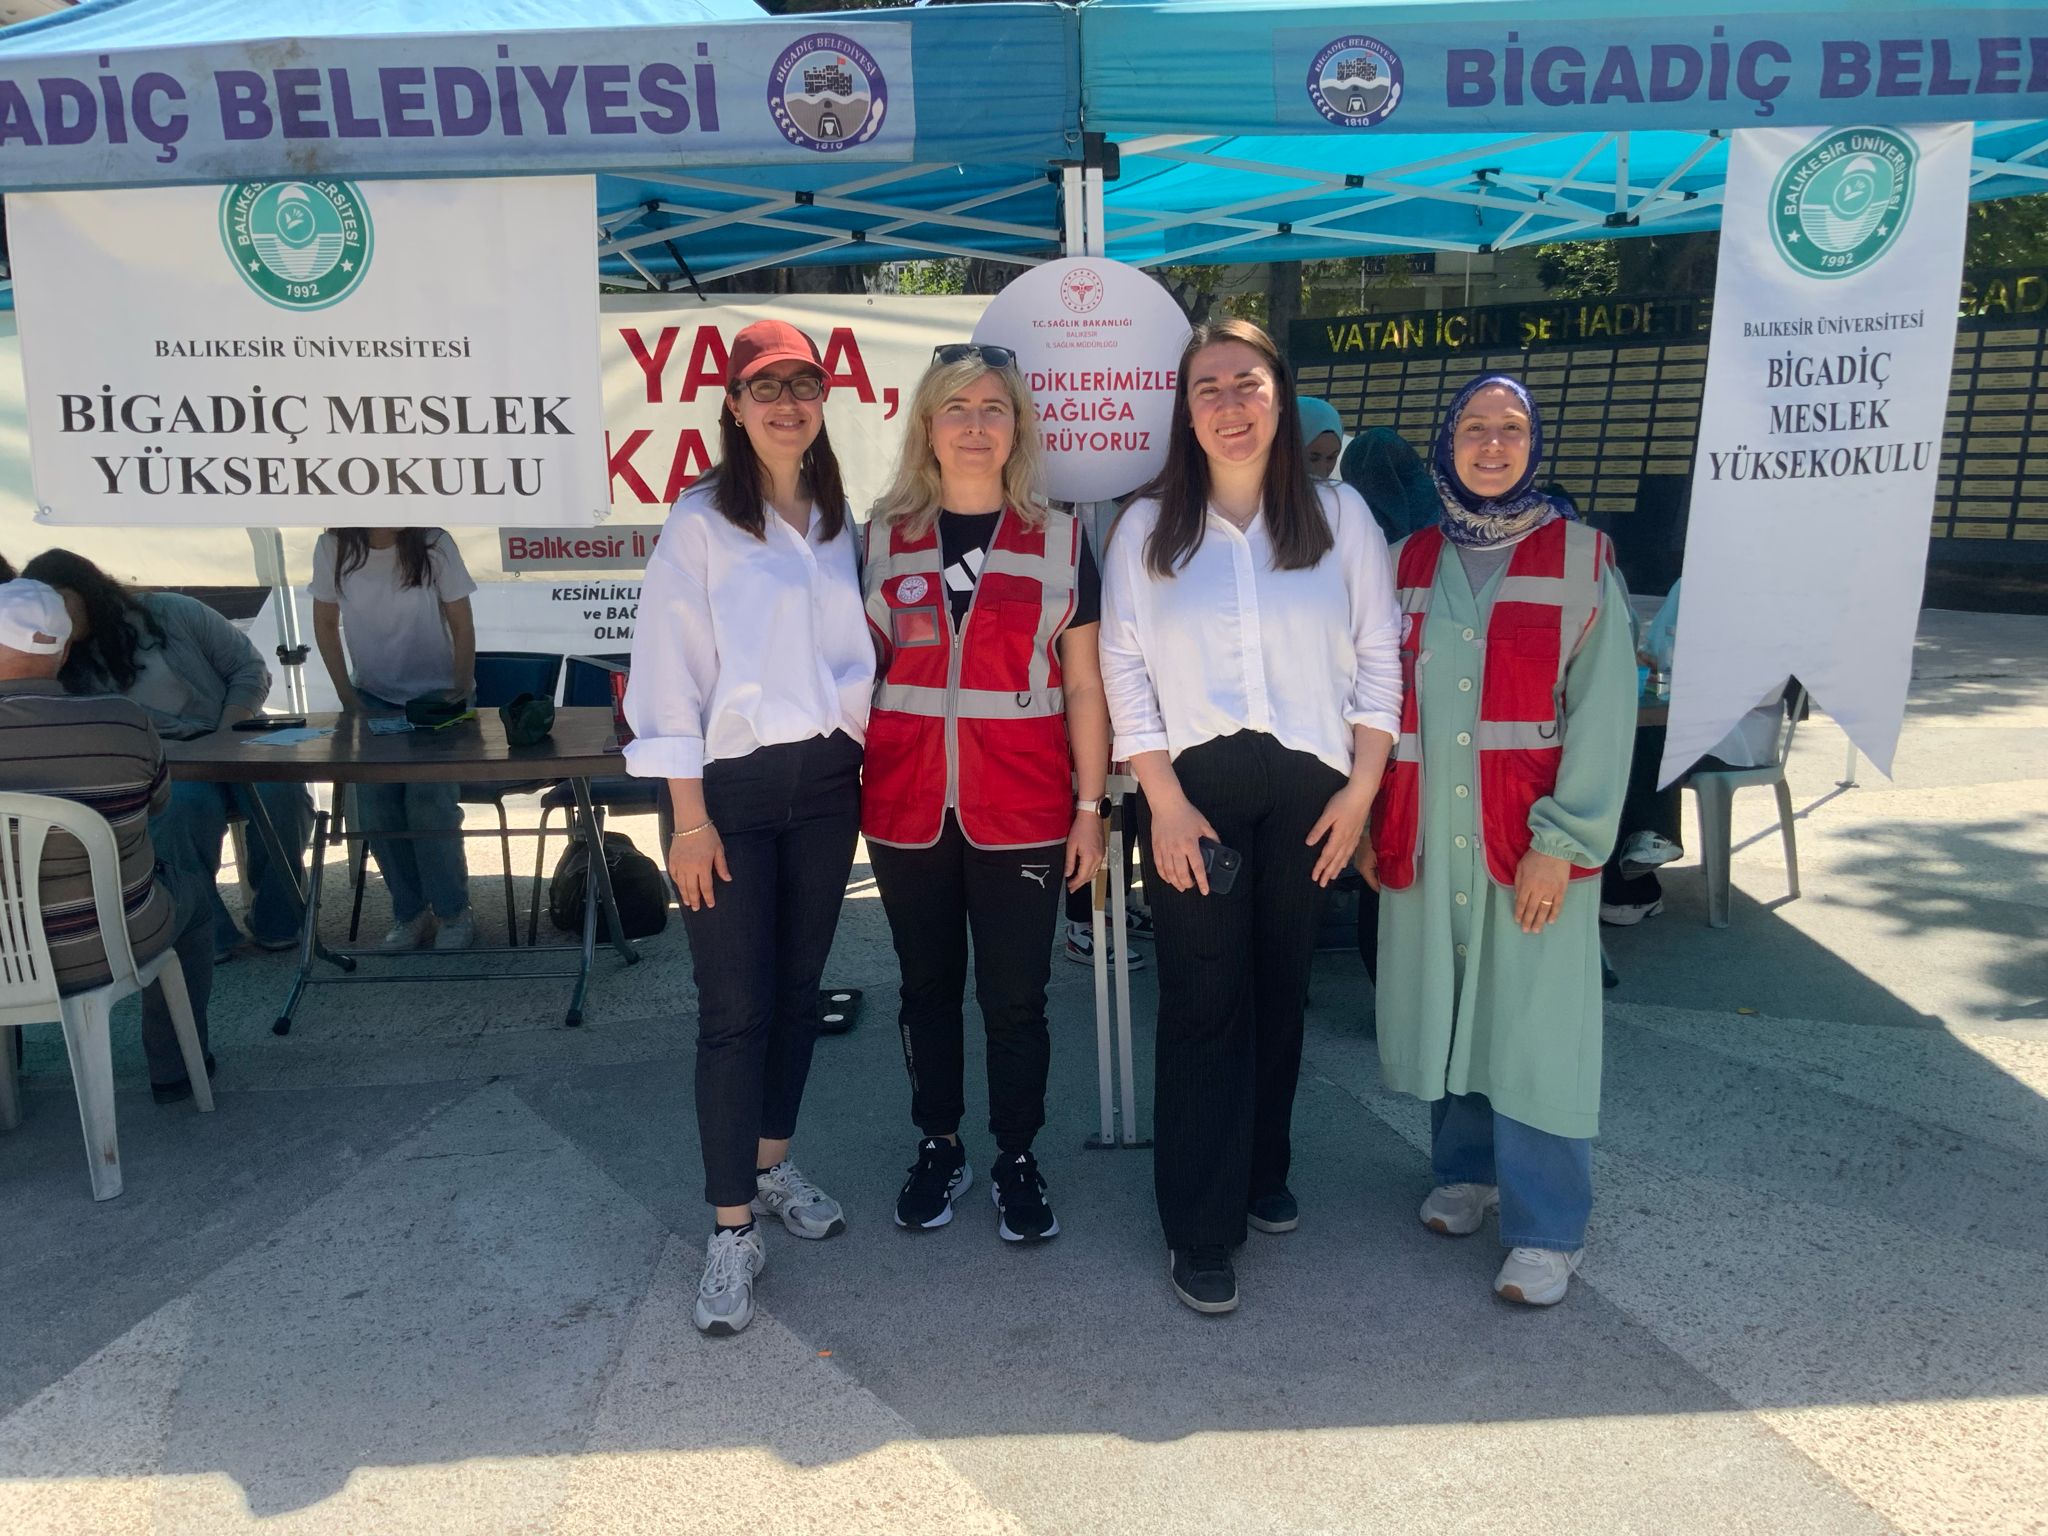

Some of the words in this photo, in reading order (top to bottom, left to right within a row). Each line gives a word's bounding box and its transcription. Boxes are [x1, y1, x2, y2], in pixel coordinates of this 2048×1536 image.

[1446, 25, 1792, 117] BİGADİÇ
[0, 54, 189, 163] ADİÇ
[215, 42, 720, 141] BELEDİYESİ
[1344, 118, 1369, 126] 1810
[1784, 141, 1848, 216] BALIKESİR
[1851, 134, 1908, 210] ÜNİVERSİTESİ
[1820, 252, 1854, 268] 1992
[286, 284, 320, 298] 1992
[1032, 320, 1046, 328] T.C.
[1047, 319, 1079, 328] SAĞLIK
[1083, 318, 1133, 327] BAKANLIĞI
[1066, 330, 1098, 338] BALIKESİR
[1327, 318, 1424, 353] VATAN
[1743, 318, 1814, 338] BALIKESİR
[1818, 310, 1924, 335] ÜNİVERSİTESİ
[155, 337, 285, 359] BALIKESİR
[294, 335, 472, 359] ÜNİVERSİTESİ
[619, 325, 899, 421] YAA,
[1025, 366, 1177, 391] DİKLERİMİZLE
[1766, 346, 1891, 389] BİGADİÇ
[57, 384, 308, 444] BİGADİÇ
[326, 395, 575, 436] MESLEK
[1768, 399, 1891, 435] MESLEK
[92, 446, 545, 497] YÜKSEKOKULU
[1710, 441, 1934, 481] YÜKSEKOKULU
[508, 535, 625, 560] Balıkesir
[583, 610, 602, 620] ve
